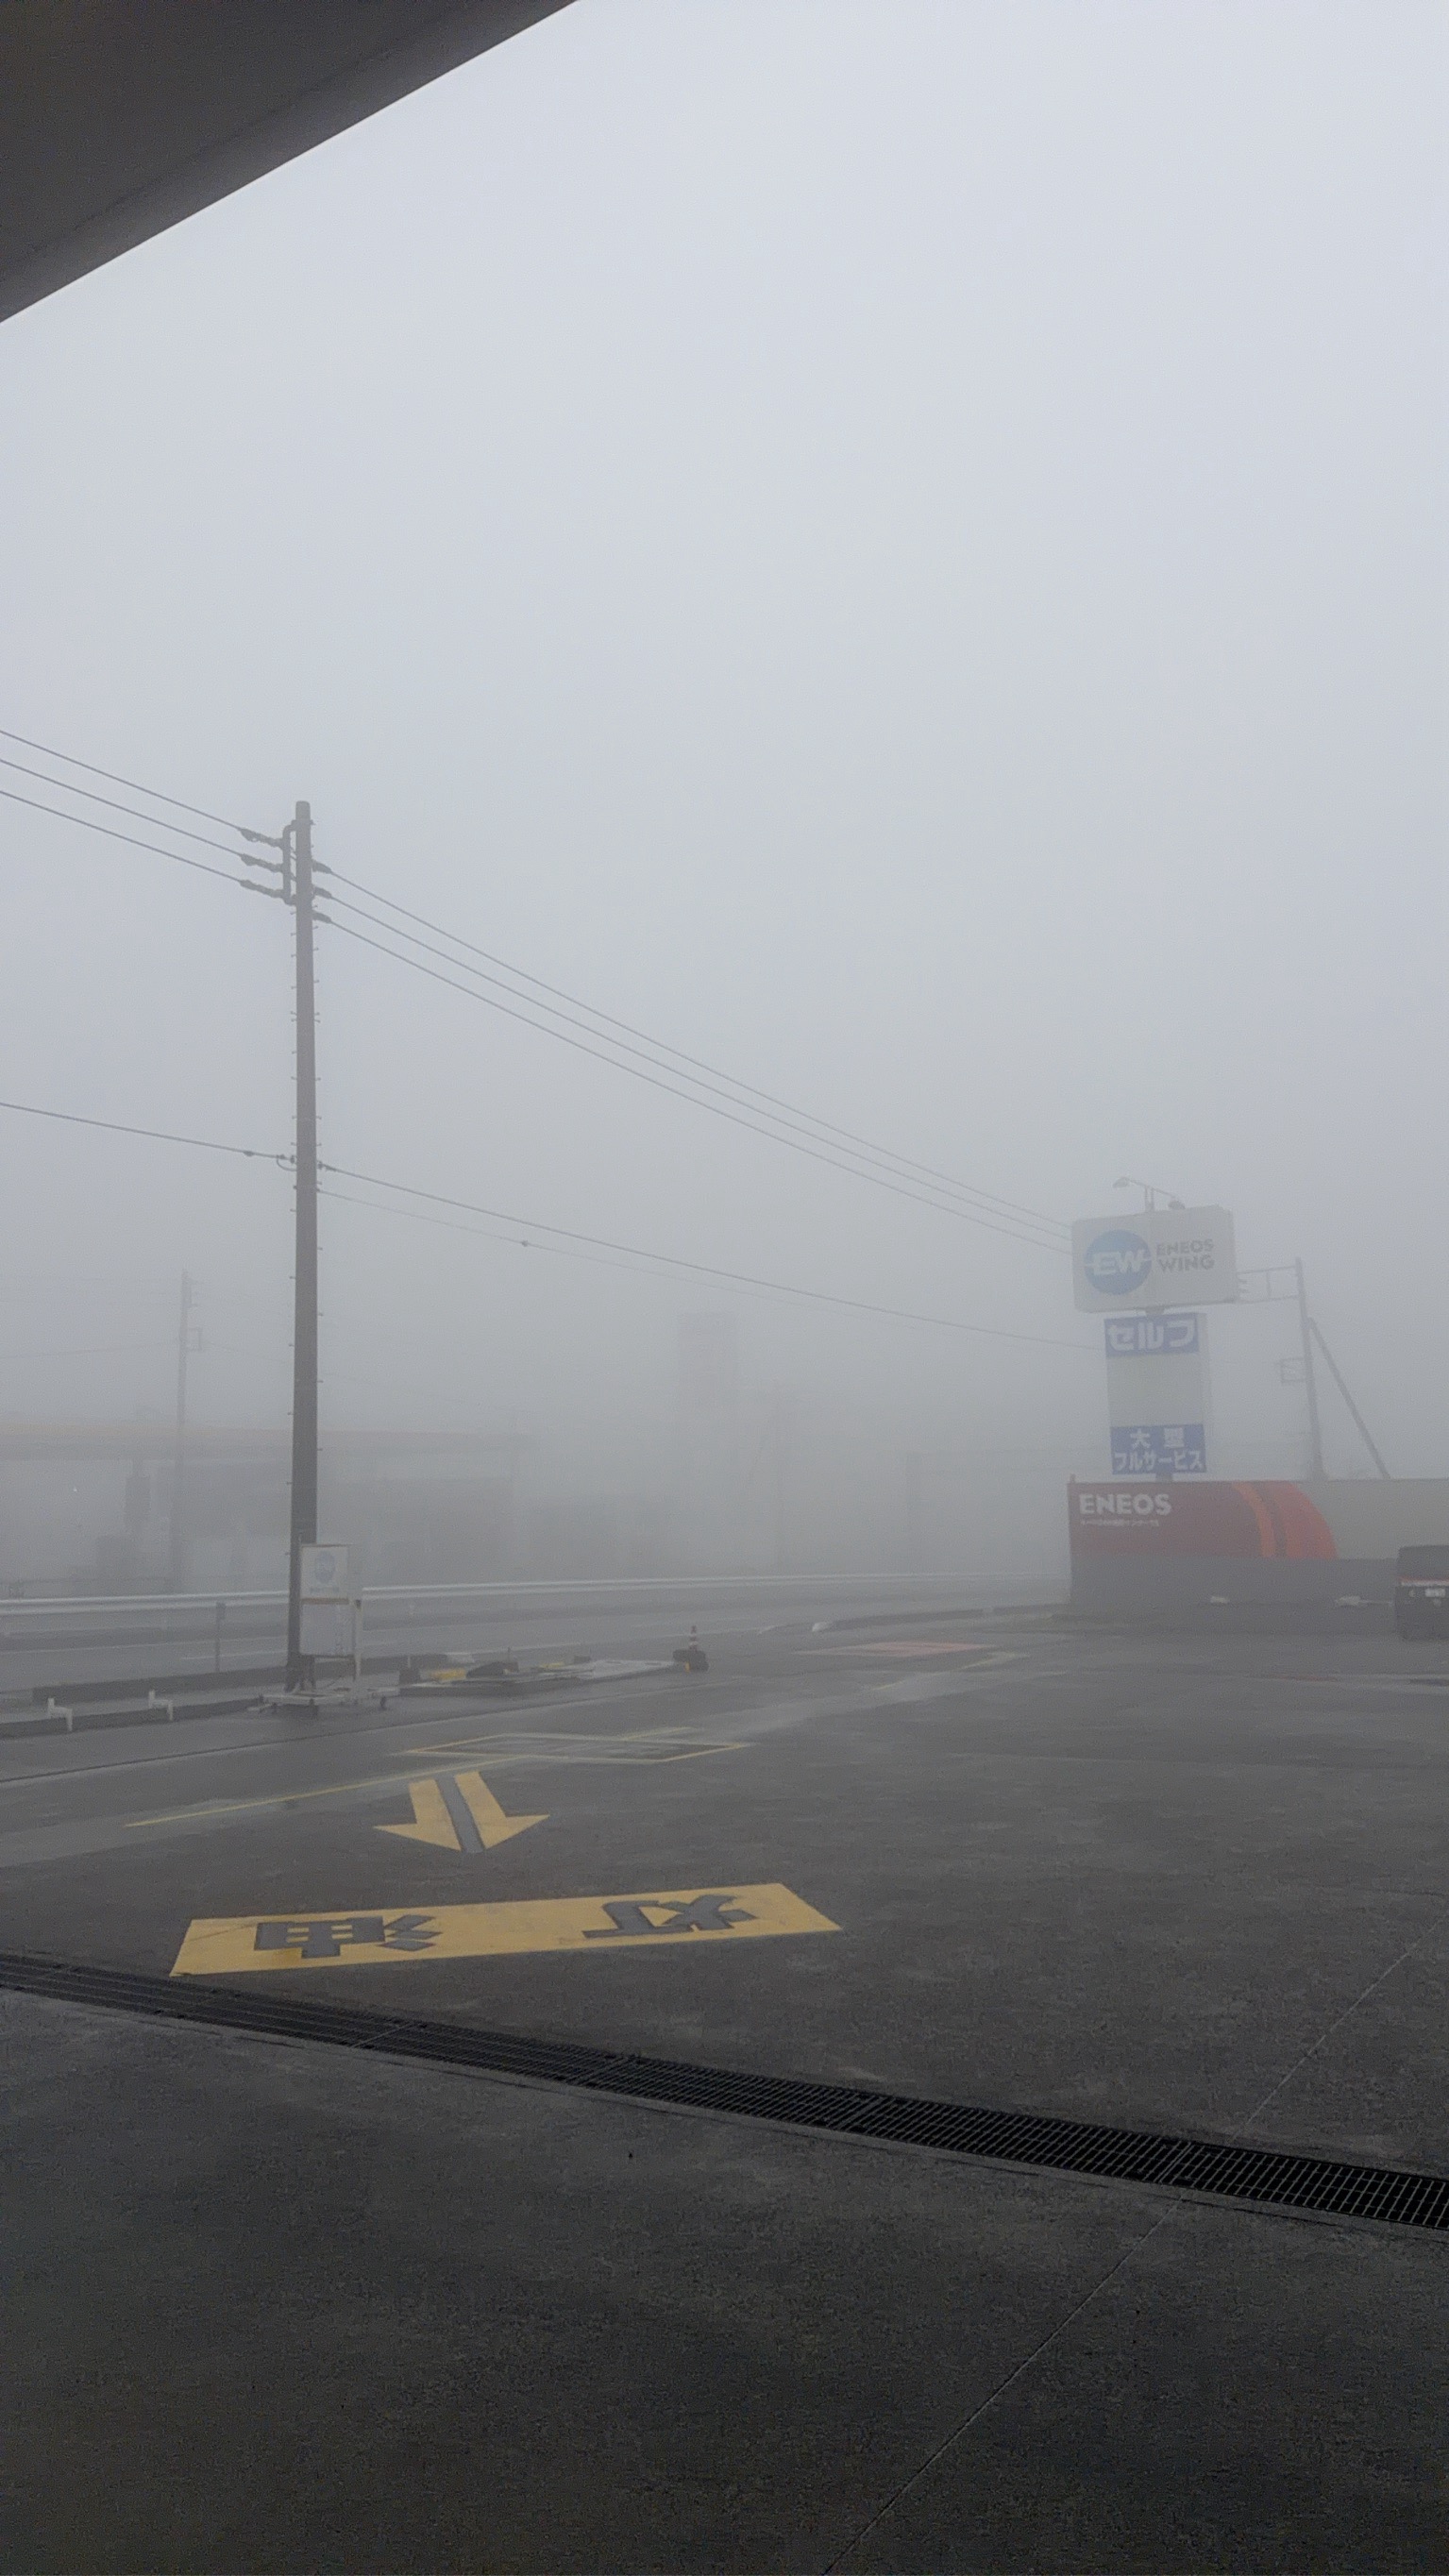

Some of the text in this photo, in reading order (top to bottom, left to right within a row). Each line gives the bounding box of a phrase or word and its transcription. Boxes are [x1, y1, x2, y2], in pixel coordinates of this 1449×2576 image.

[1156, 1238, 1215, 1256] ENEOS
[1157, 1254, 1215, 1272] WING
[1106, 1320, 1197, 1352] セルフ
[1114, 1450, 1203, 1472] フルサービス
[1079, 1493, 1171, 1516] ENEOS
